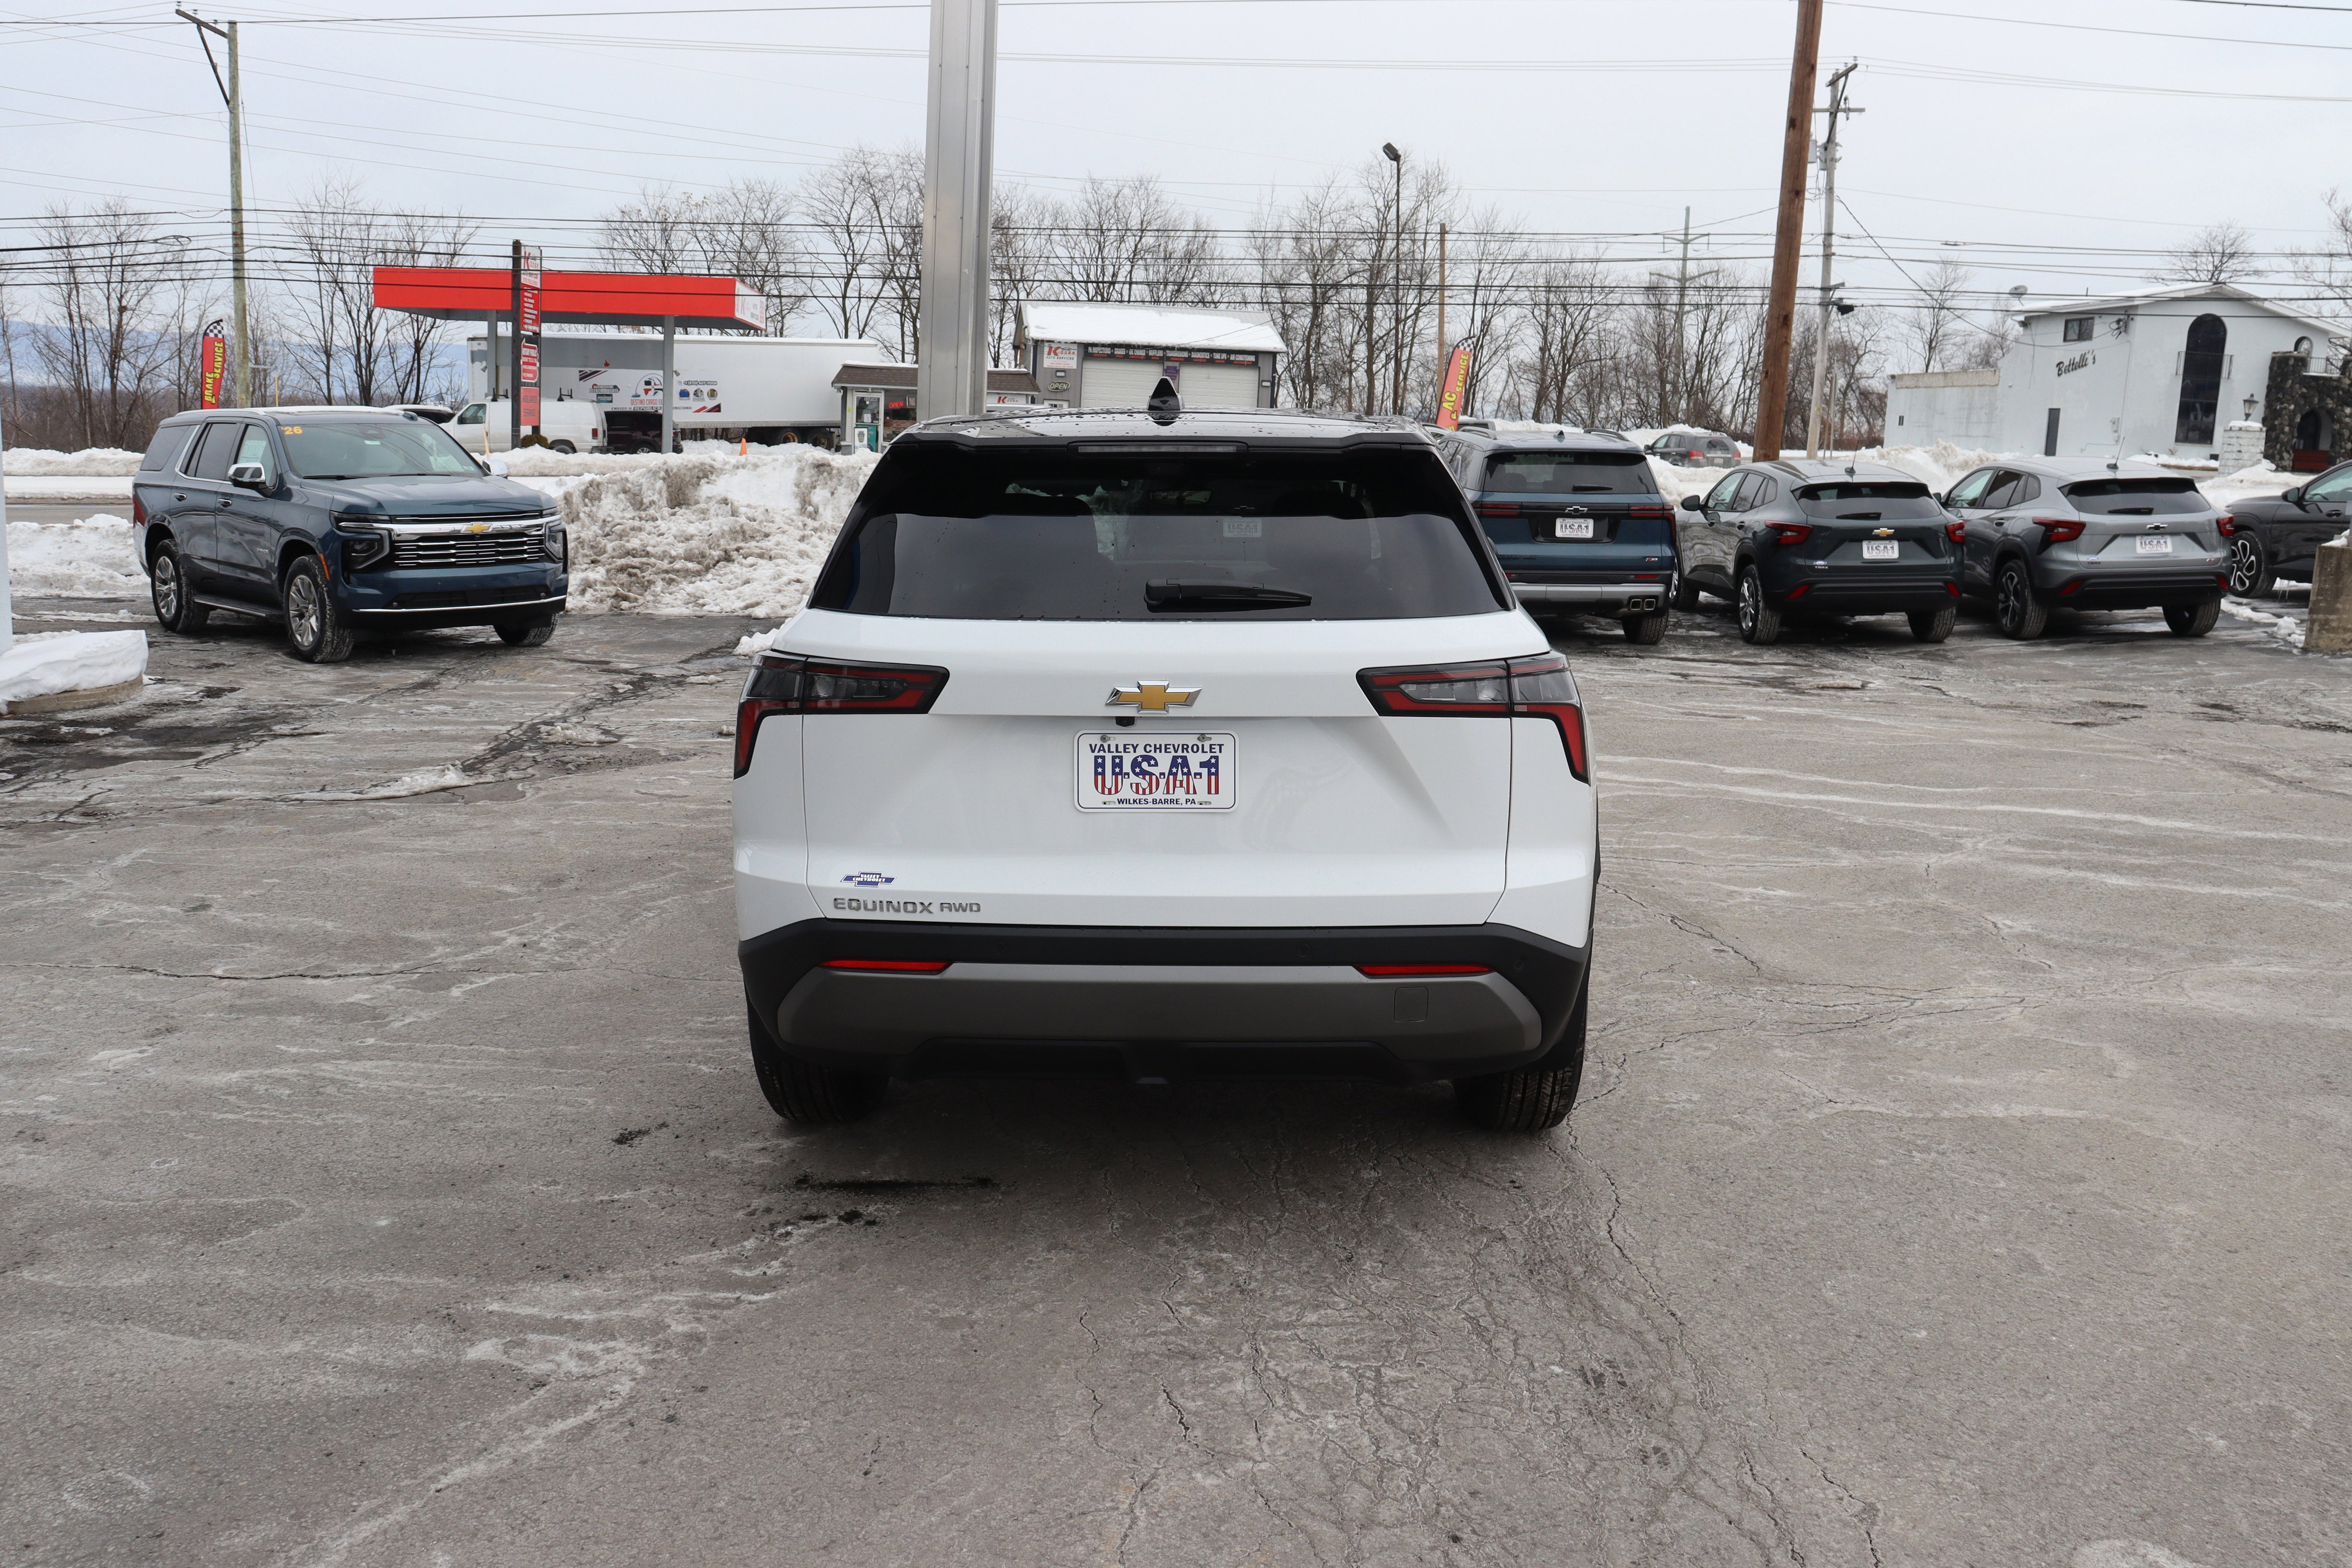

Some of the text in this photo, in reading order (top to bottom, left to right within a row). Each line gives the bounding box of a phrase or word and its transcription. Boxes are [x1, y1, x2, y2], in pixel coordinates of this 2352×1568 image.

[214, 341, 223, 379] SERVICE
[1456, 353, 1469, 392] SERVICE
[204, 372, 214, 401] BRAKE
[1442, 391, 1457, 411] AC
[1089, 744, 1225, 753] VALLEY CHEVROLET
[833, 898, 981, 914] EQUINOX AWD
